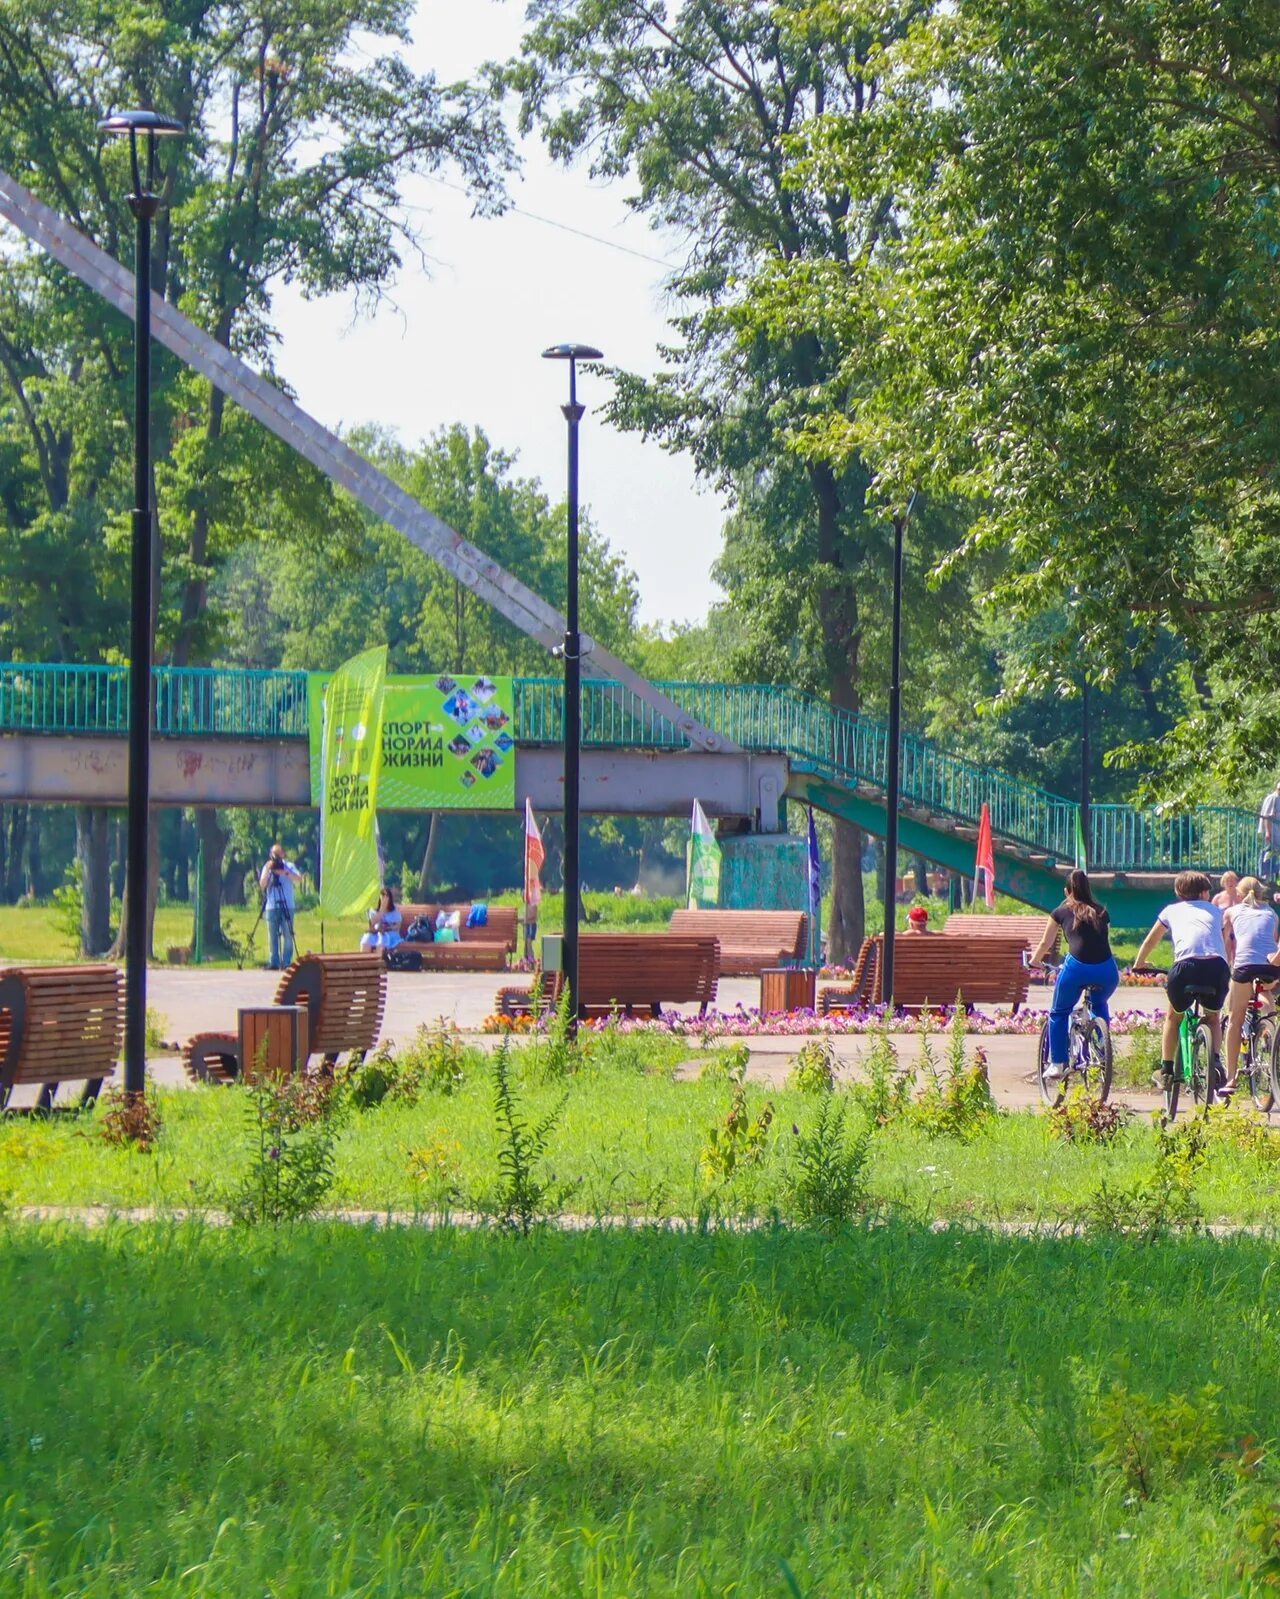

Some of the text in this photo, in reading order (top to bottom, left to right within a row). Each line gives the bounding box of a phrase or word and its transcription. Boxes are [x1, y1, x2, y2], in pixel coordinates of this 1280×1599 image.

[382, 737, 443, 751] НОРМА
[382, 752, 443, 767] ЖИЗНИ
[330, 798, 369, 815] ЖИНИ
